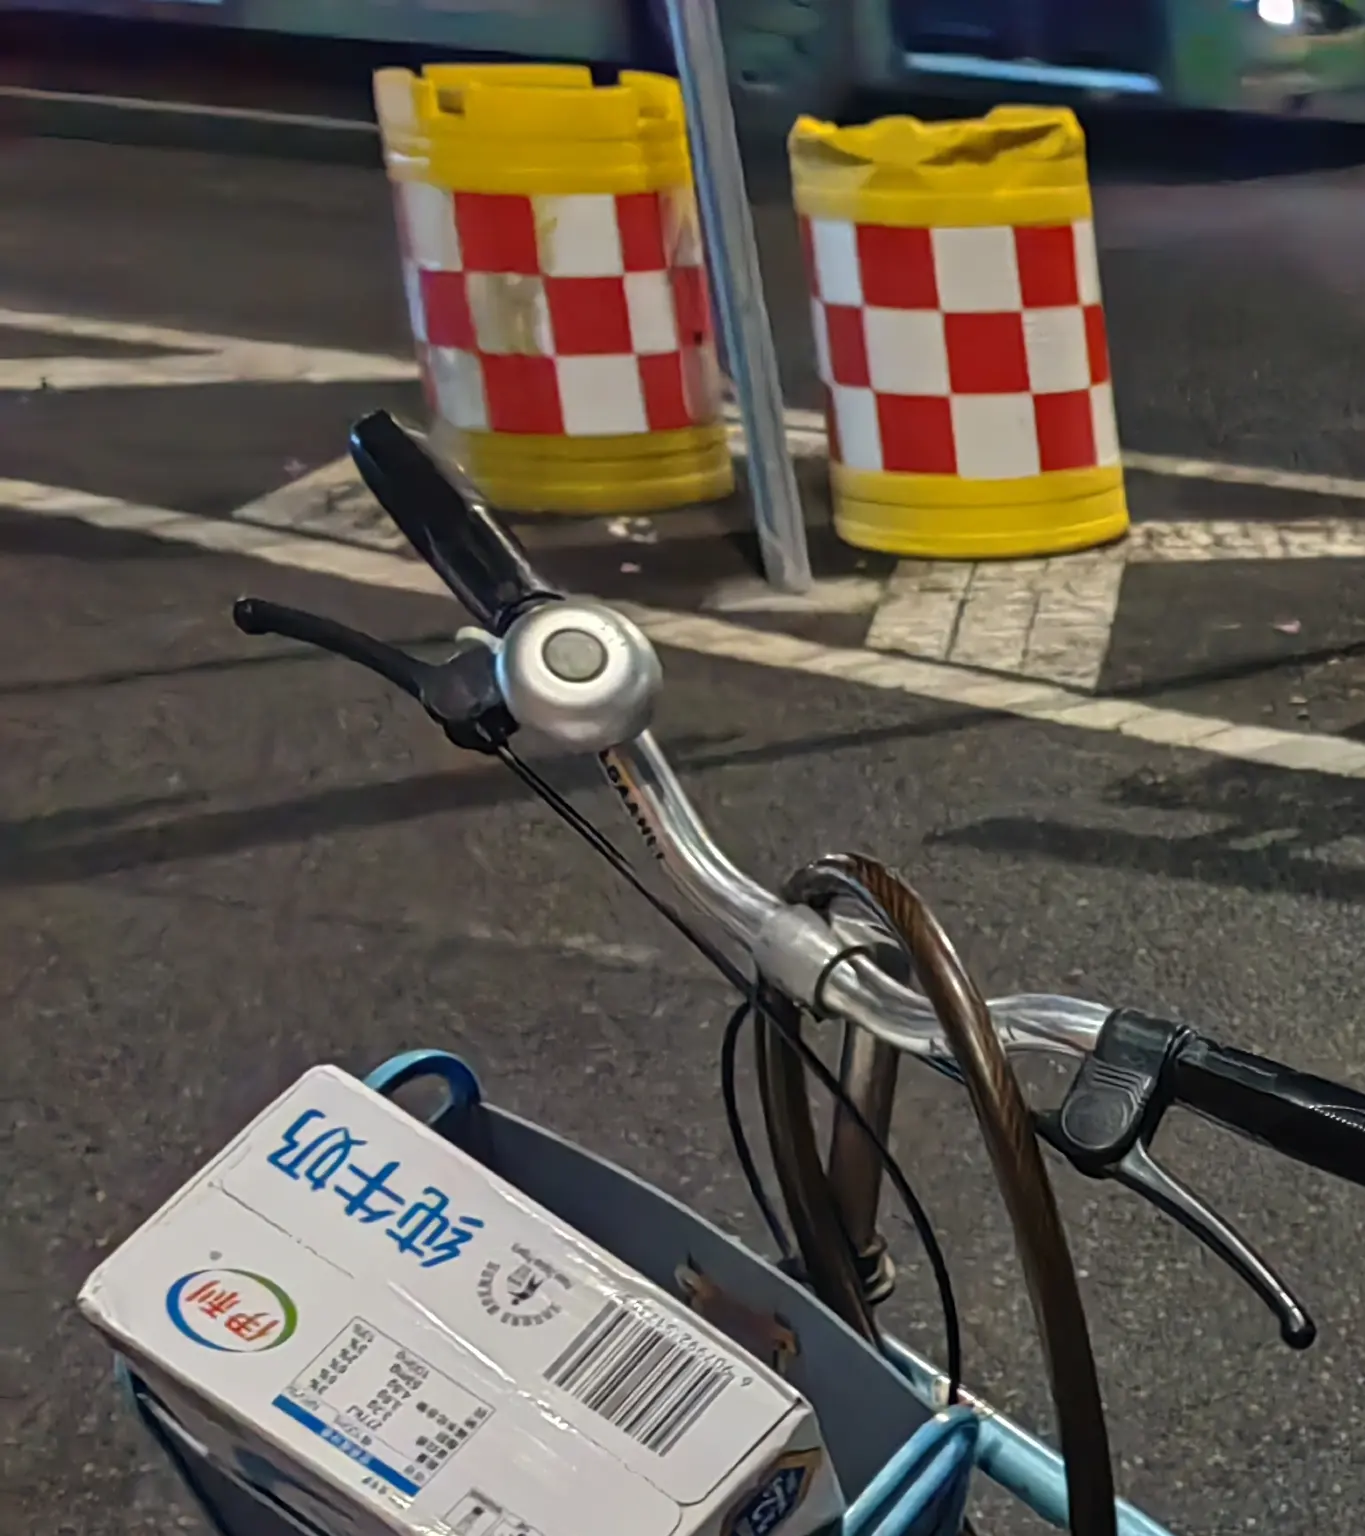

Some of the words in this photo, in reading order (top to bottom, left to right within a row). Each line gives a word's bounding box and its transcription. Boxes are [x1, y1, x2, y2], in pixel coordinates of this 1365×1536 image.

[267, 1109, 485, 1268] 纯牛奶
[184, 1280, 280, 1341] 伊利
